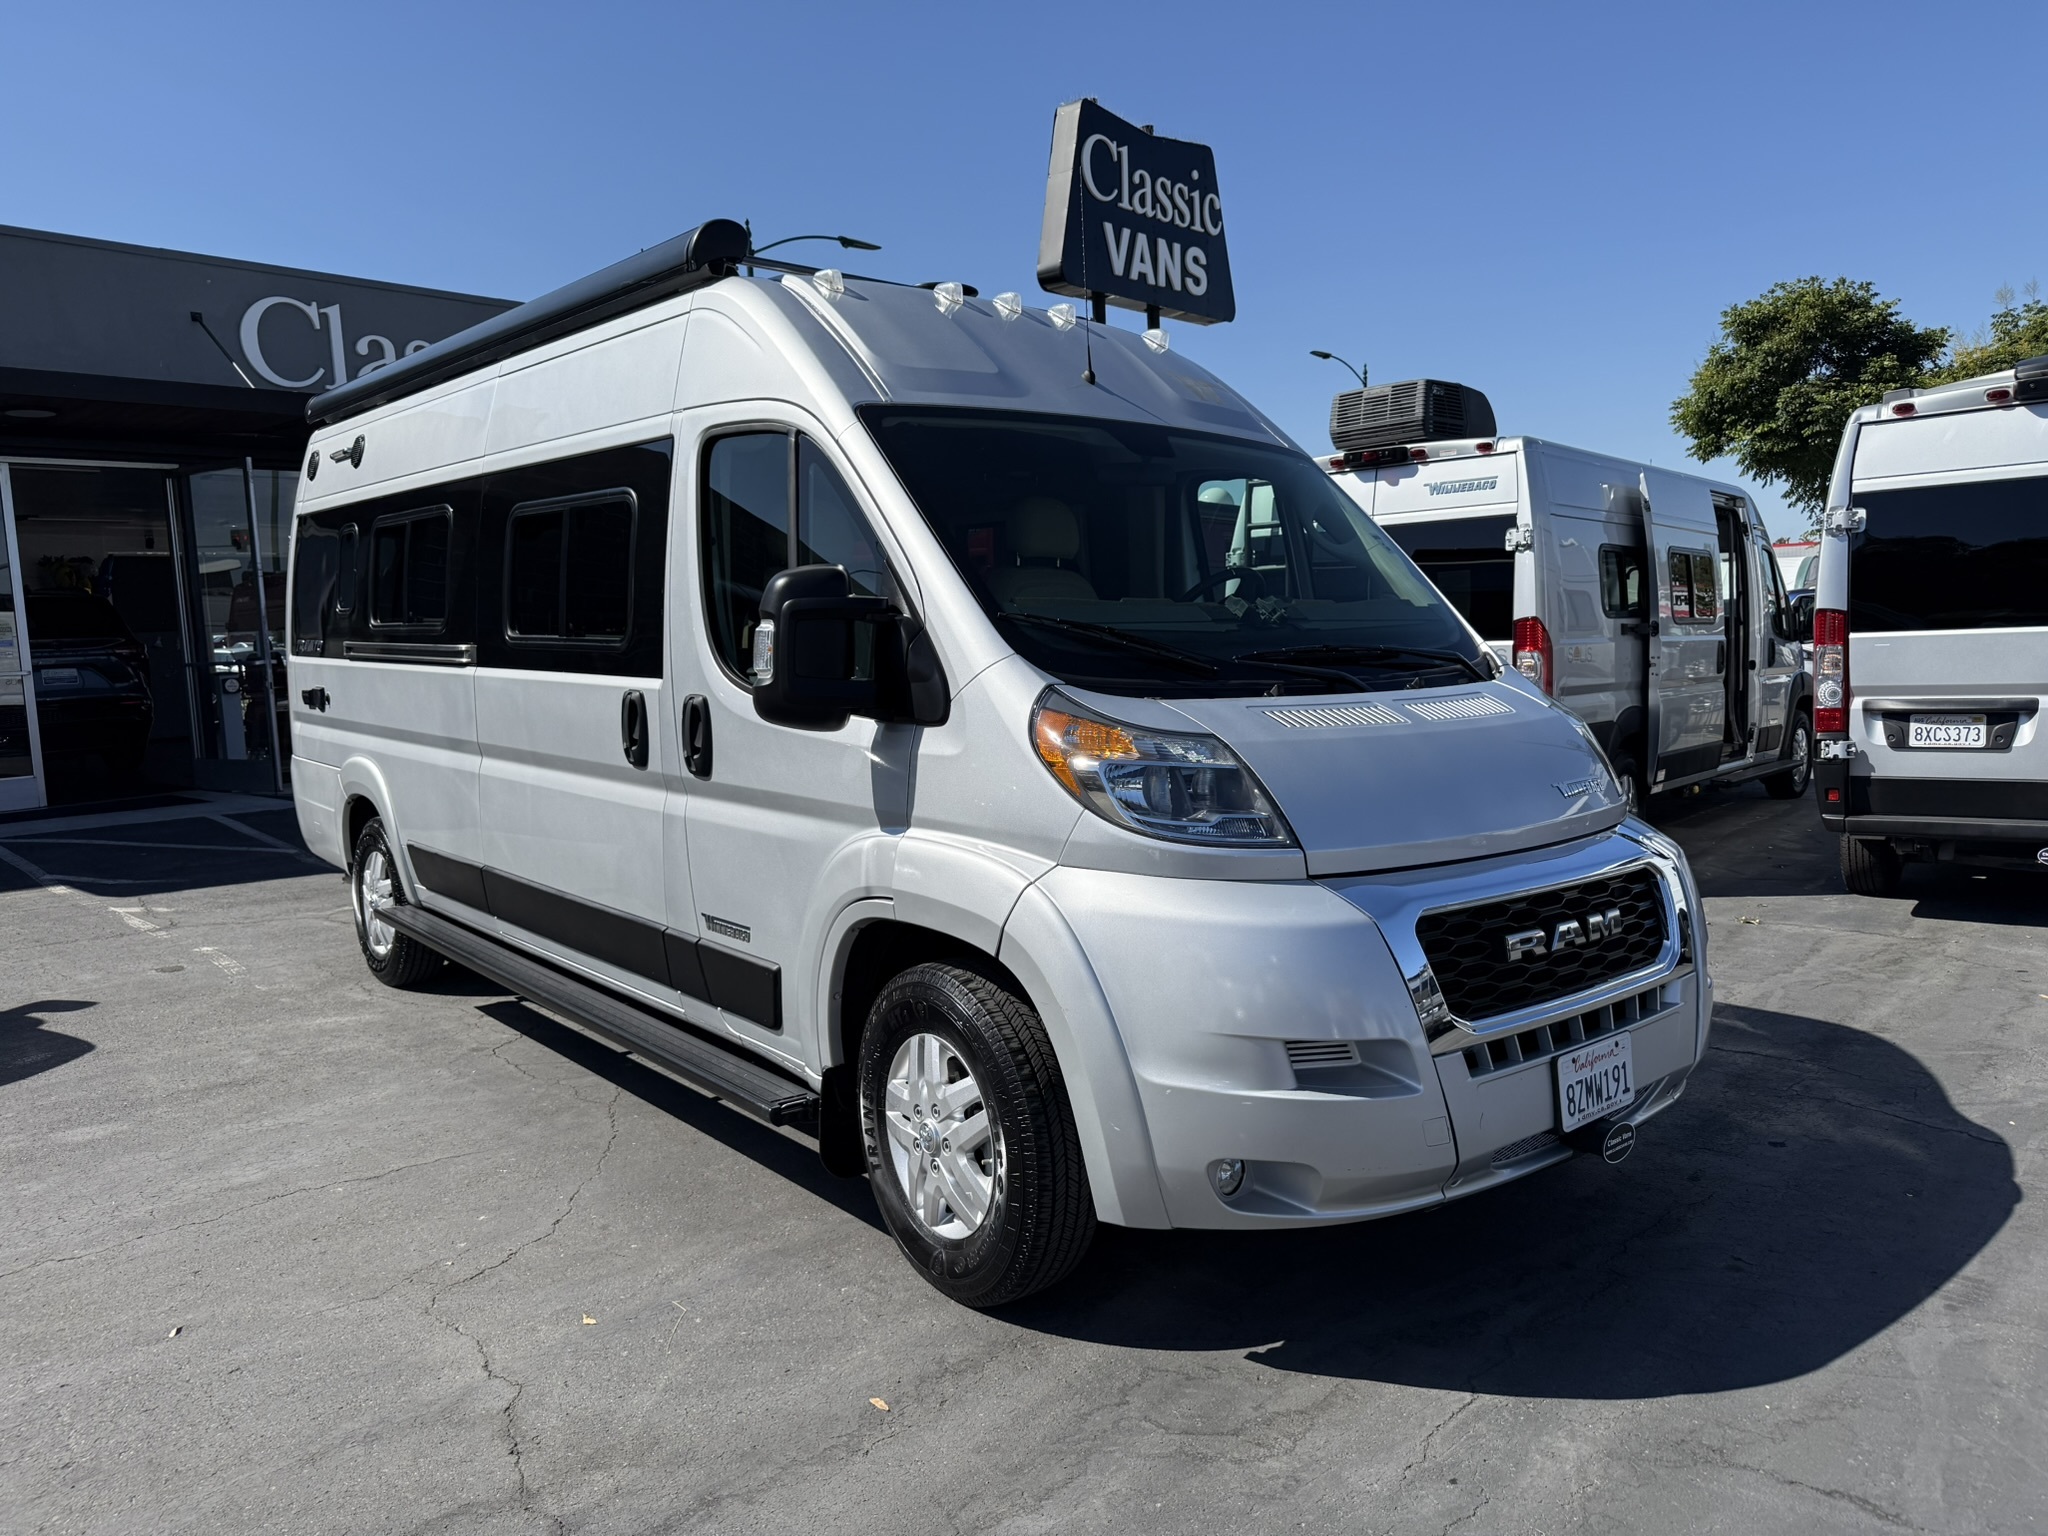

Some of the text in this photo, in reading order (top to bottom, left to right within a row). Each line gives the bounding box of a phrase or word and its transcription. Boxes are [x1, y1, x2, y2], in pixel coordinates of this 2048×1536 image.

[1081, 134, 1222, 237] Classic
[1103, 222, 1208, 297] VANS
[1423, 475, 1498, 496] WINNEBAGO
[1914, 726, 1981, 743] 8XCS373
[1505, 908, 1622, 962] RAM
[1573, 1047, 1620, 1074] California
[1566, 1060, 1631, 1118] 8ZMW191
[1581, 1100, 1619, 1121] dmv.ca.gov
